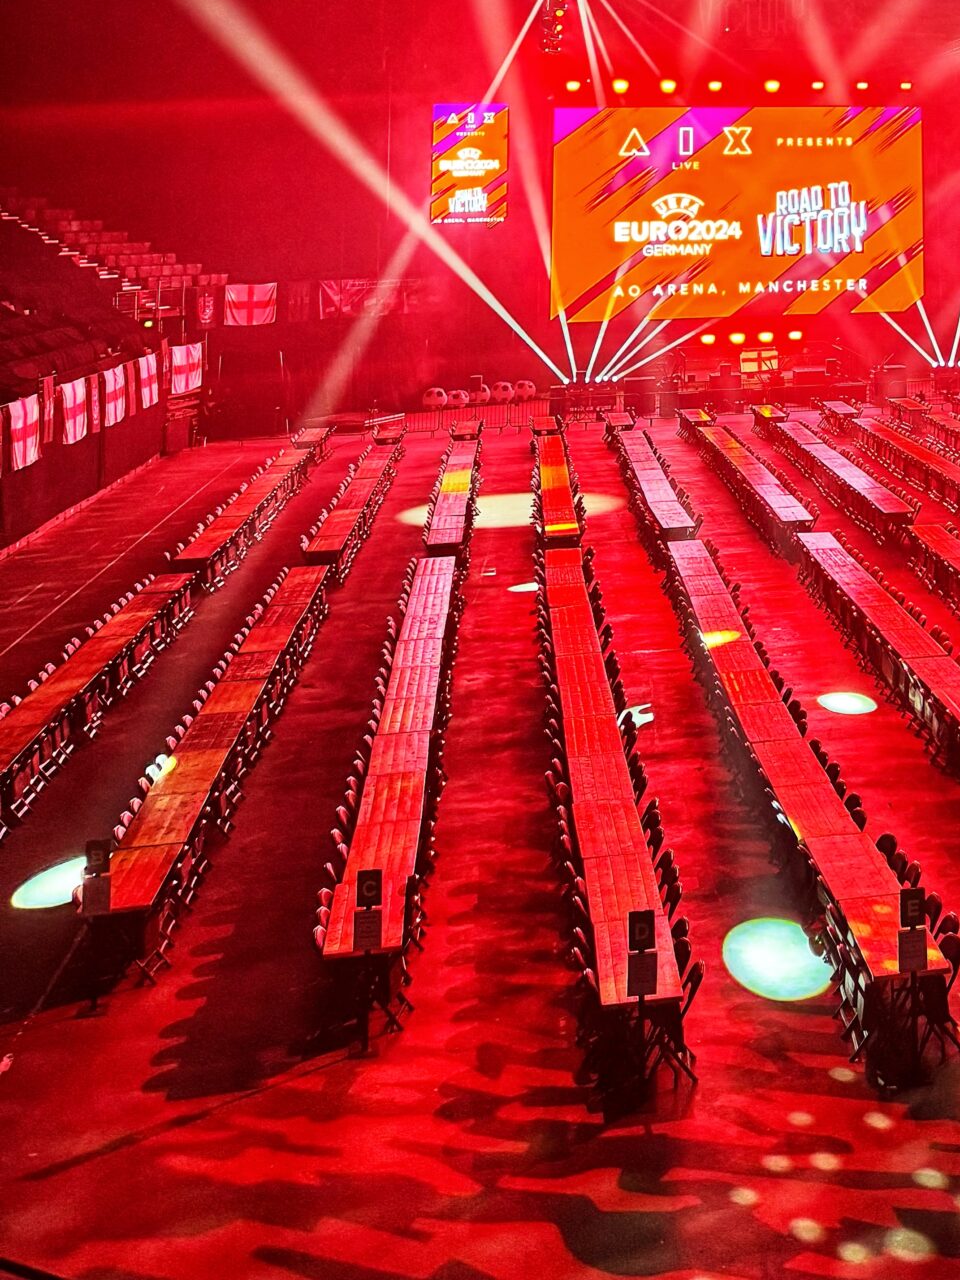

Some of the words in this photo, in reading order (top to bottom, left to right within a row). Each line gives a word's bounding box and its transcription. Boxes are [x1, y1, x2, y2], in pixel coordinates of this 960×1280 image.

[776, 137, 854, 147] PRESENTS
[671, 161, 700, 170] LIVE
[655, 195, 700, 217] UEFA
[775, 186, 824, 216] ROAD
[828, 181, 851, 210] TO
[757, 200, 867, 257] VICTORY
[642, 243, 712, 257] GERMANY
[613, 285, 641, 298] AO
[652, 283, 727, 297] ARENA,
[738, 278, 869, 294] MANCHESTER
[362, 880, 376, 898] C
[907, 899, 921, 916] E
[634, 923, 649, 940] D
